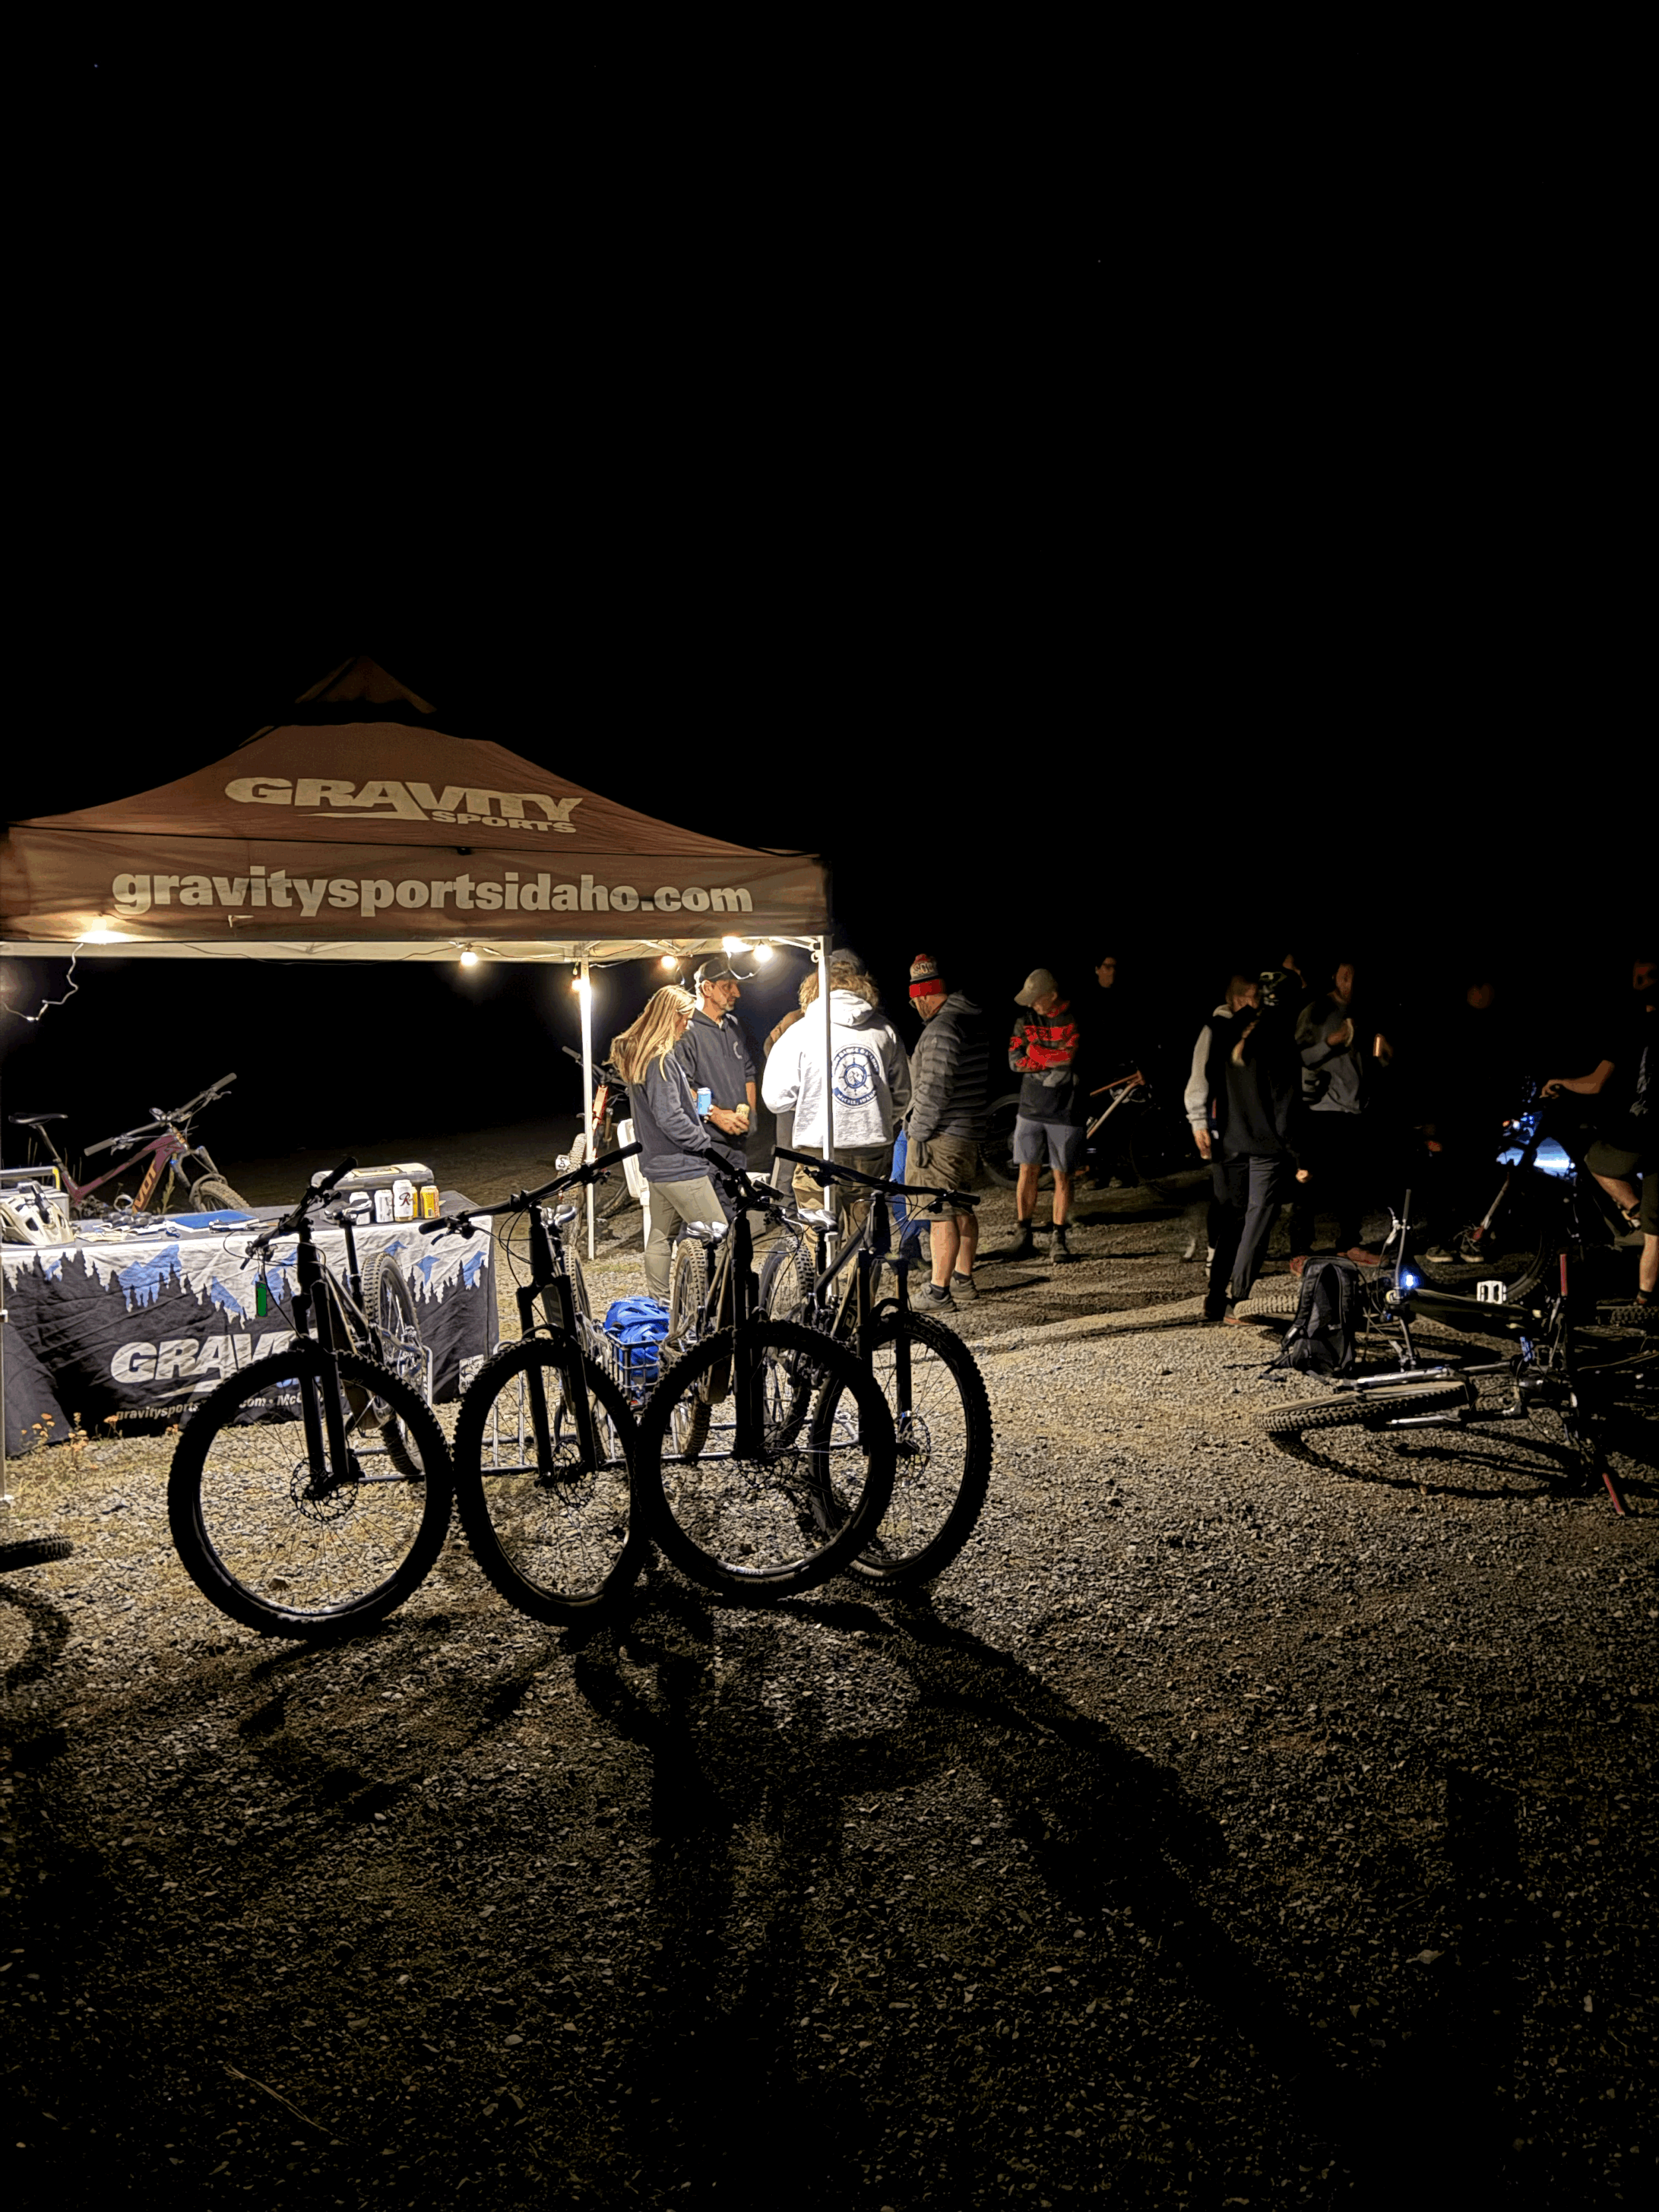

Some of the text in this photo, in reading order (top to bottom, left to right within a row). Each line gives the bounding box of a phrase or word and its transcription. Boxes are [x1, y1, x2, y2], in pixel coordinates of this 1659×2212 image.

[224, 776, 583, 822] GRAVITY
[432, 810, 577, 833] SPORTS
[111, 865, 753, 917] gravitysportsidaho.com
